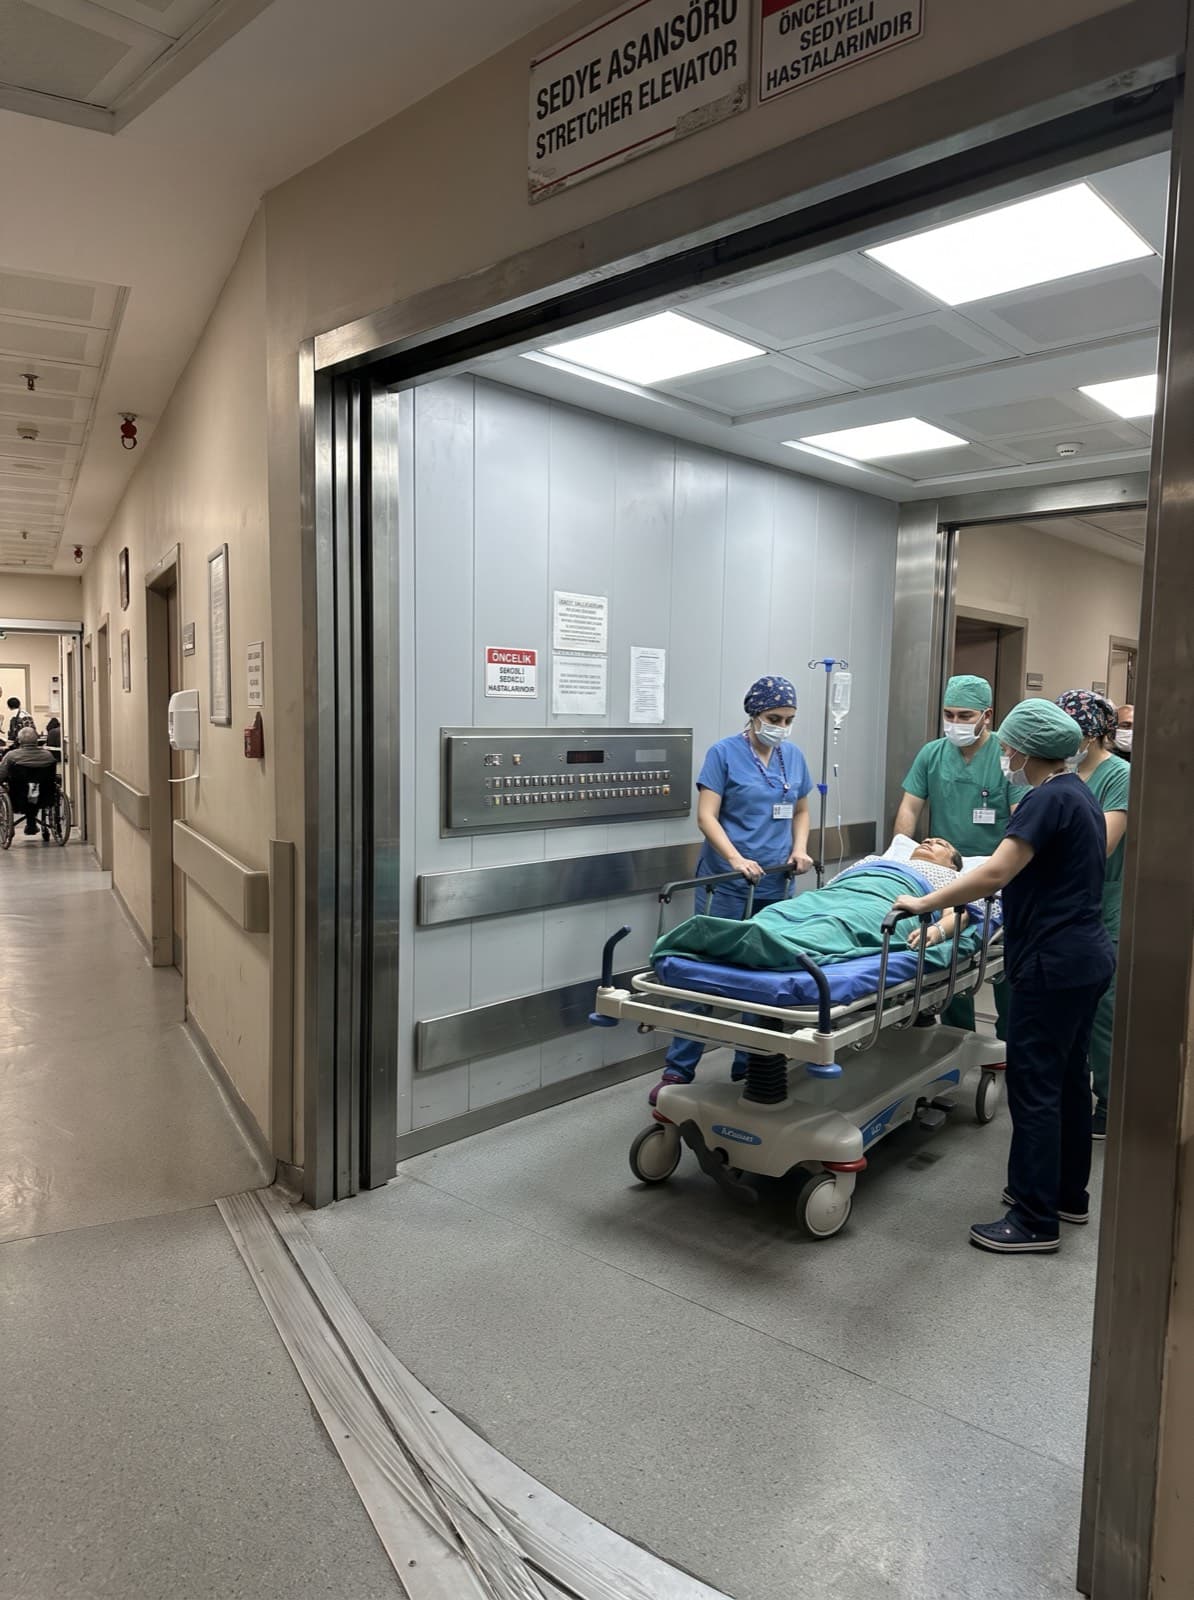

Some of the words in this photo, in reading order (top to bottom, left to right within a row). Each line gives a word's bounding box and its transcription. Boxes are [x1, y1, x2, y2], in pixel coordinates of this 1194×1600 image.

[537, 58, 601, 120] SEDYE
[767, 11, 912, 91] HASTALARINDIR
[536, 90, 632, 159] STRETCHER
[640, 40, 737, 110] ELEVATOR
